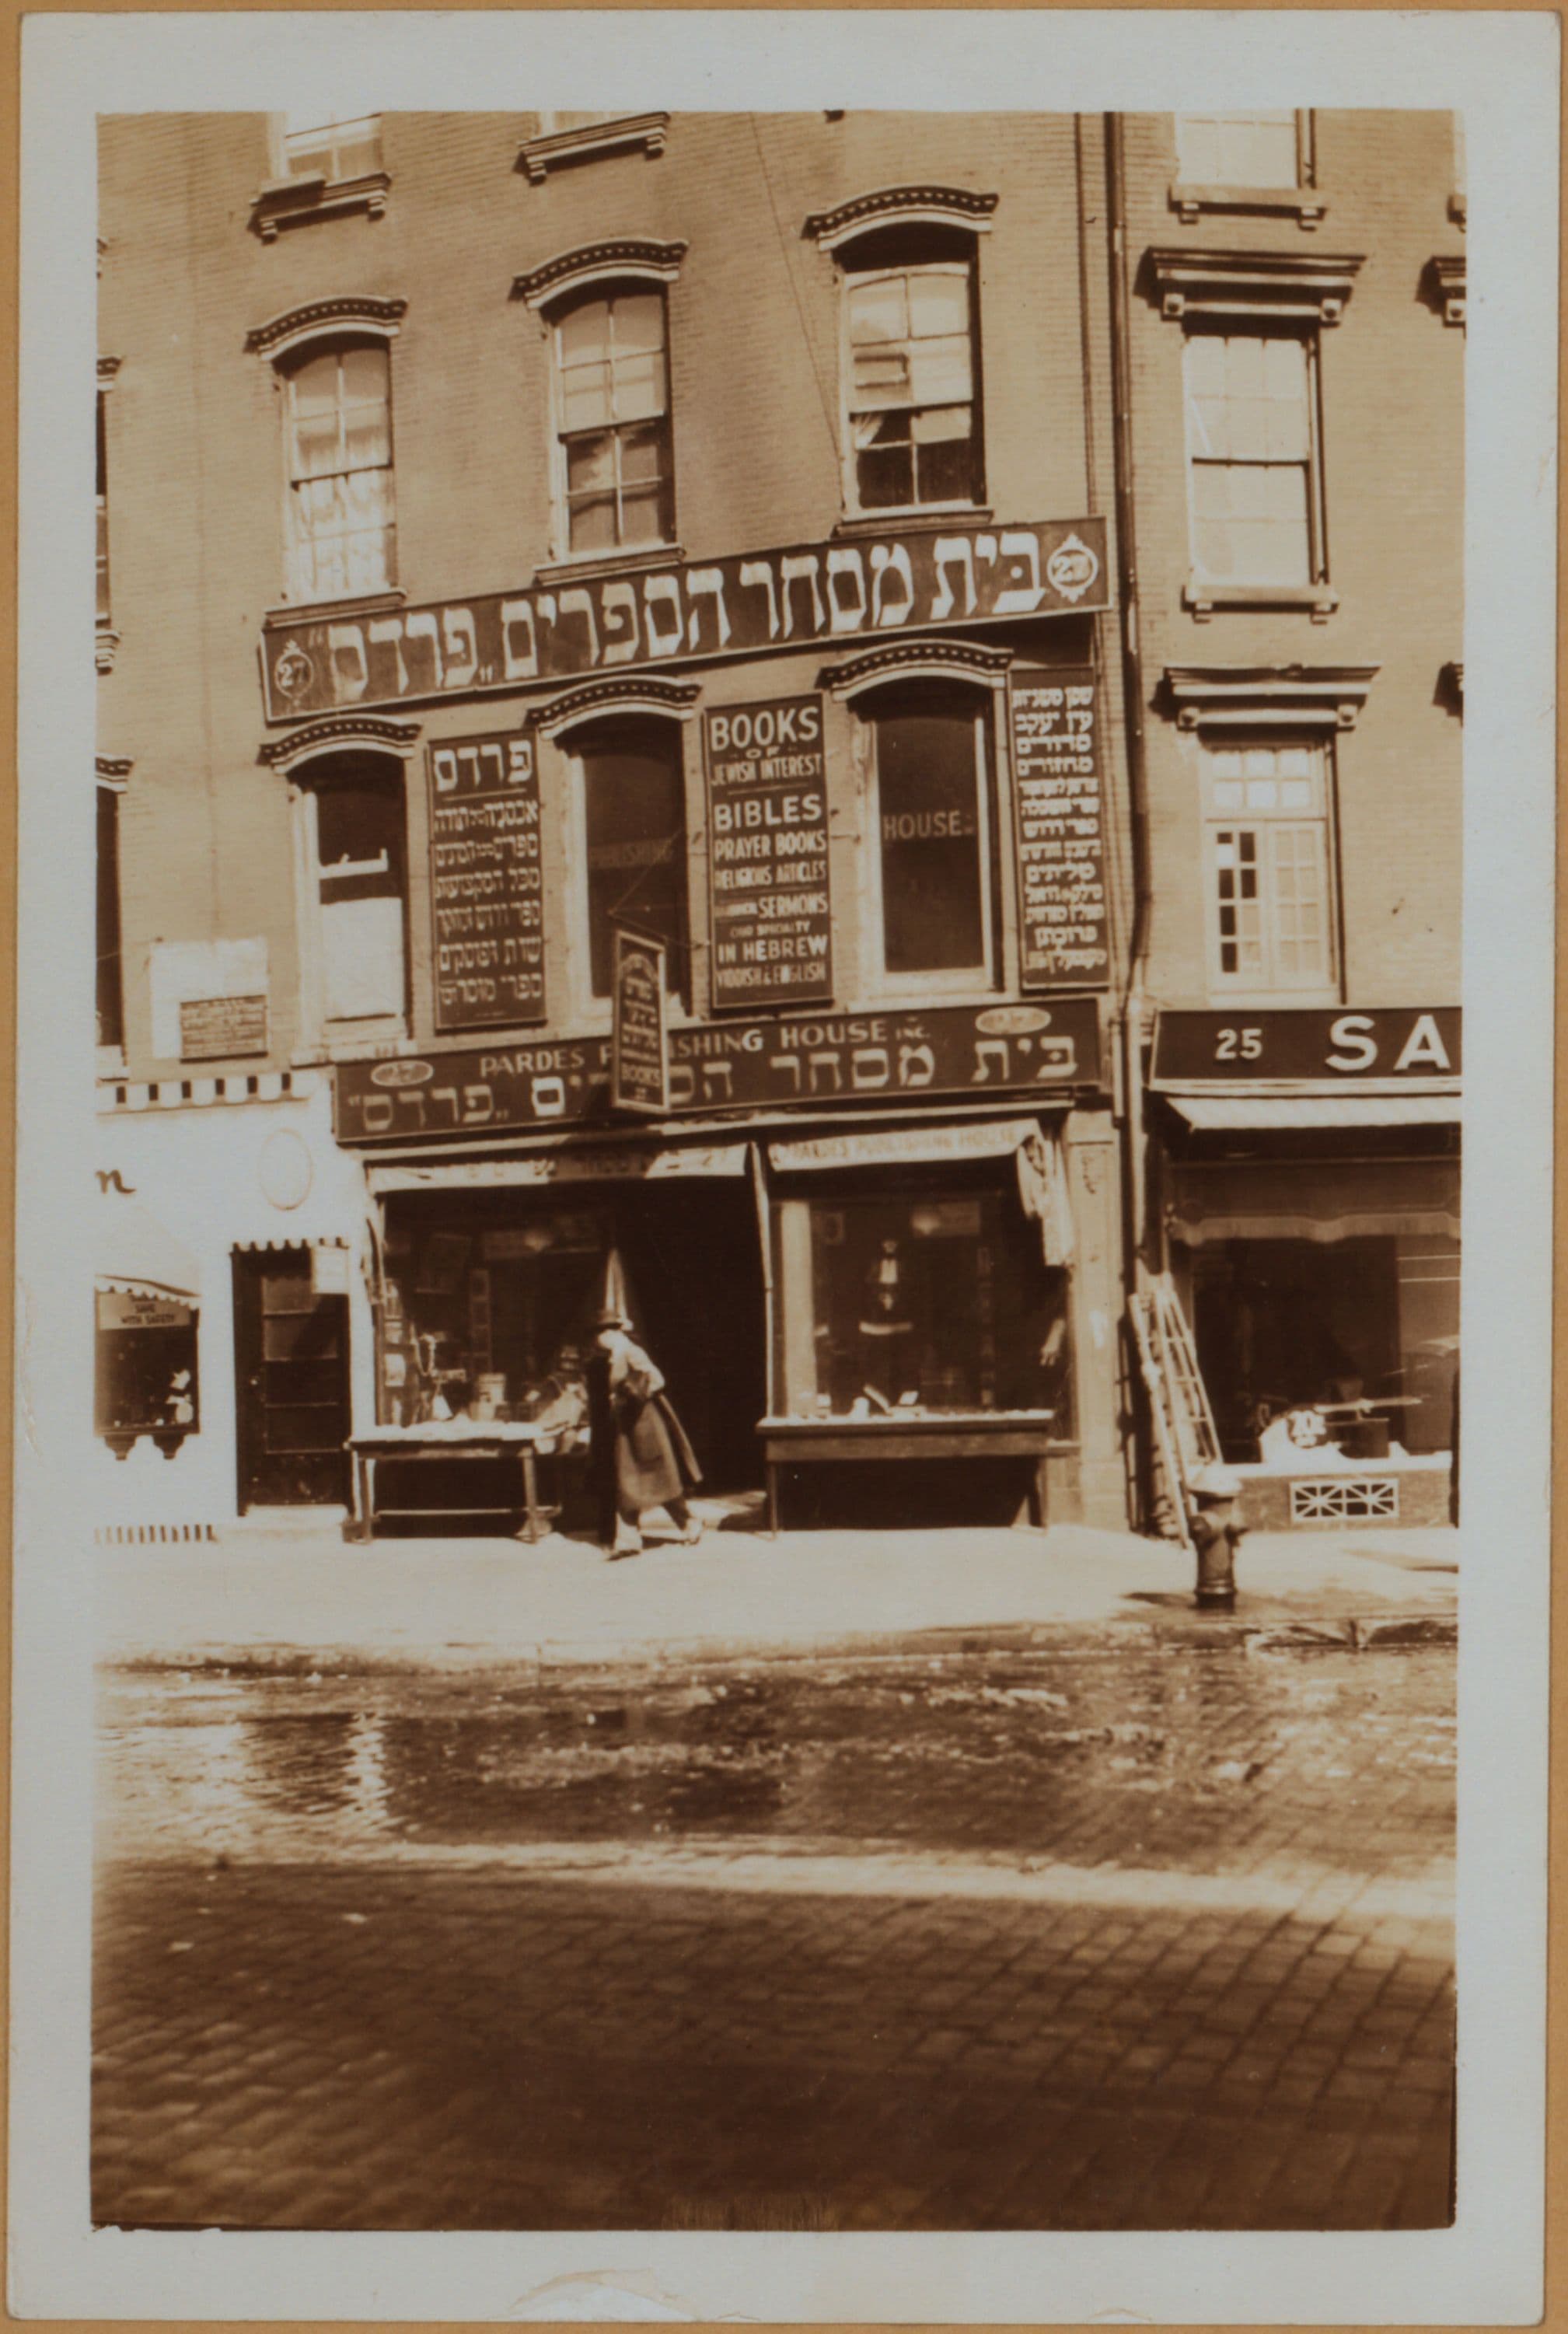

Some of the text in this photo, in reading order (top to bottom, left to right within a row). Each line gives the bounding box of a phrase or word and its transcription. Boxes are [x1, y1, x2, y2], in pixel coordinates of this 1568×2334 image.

[739, 543, 914, 641] מסחר
[931, 531, 1046, 621] בית
[501, 568, 732, 681] הספרים
[277, 661, 307, 687] 27
[711, 706, 819, 751] BOOKS
[434, 740, 532, 792] פרדס
[746, 746, 780, 759] OF
[711, 753, 822, 786] JEWISH INTEREST
[714, 794, 822, 831] BIBLES
[883, 810, 962, 840] HOUSE
[714, 829, 826, 861] PRAYER BOOKS
[777, 860, 827, 883] ARTICLES
[759, 893, 828, 919] SERMONS
[718, 935, 828, 963] IN HEBREW
[773, 961, 826, 984] ENGLISH
[480, 1047, 584, 1078] PARDES
[781, 1019, 887, 1049] HOUSE
[972, 1036, 1078, 1082] בית
[1215, 1028, 1262, 1060] 25
[770, 1044, 935, 1092] מסחר
